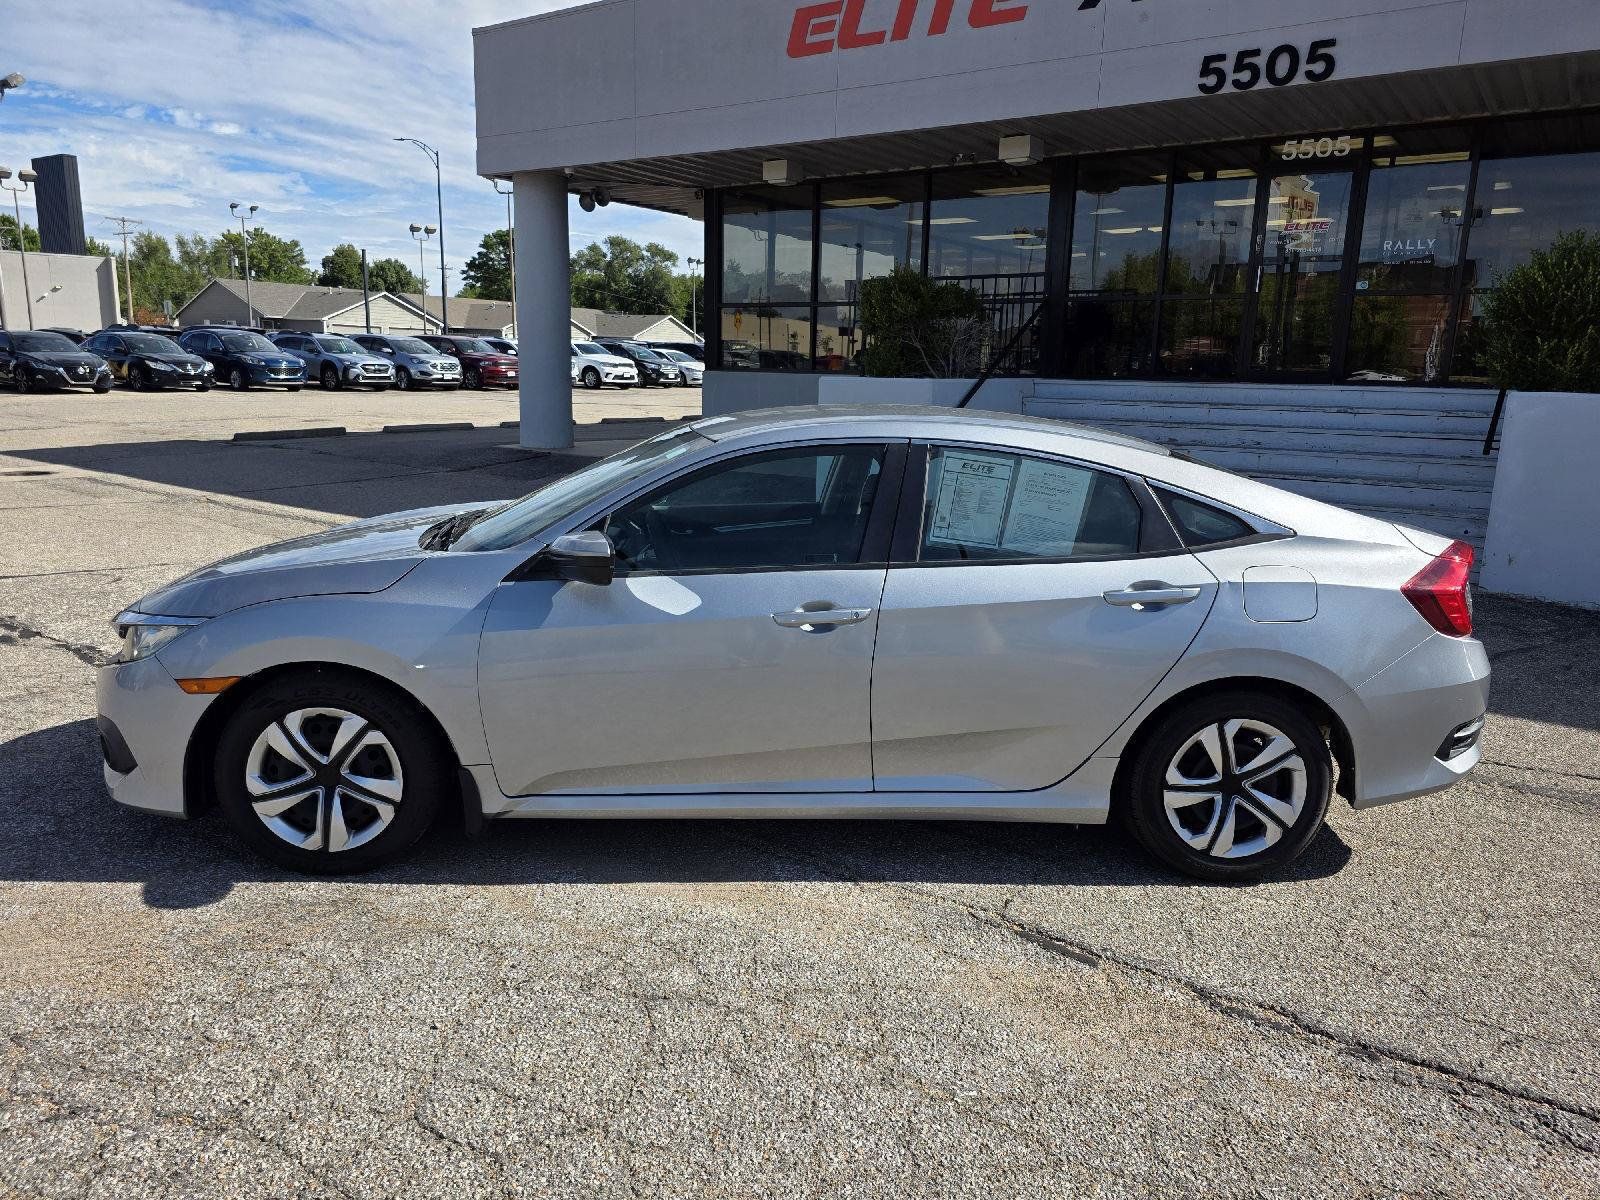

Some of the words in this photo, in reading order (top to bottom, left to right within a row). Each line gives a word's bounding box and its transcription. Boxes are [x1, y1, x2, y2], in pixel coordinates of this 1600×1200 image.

[1198, 38, 1336, 94] 5505
[1281, 136, 1351, 161] 5505
[1283, 221, 1331, 232] ELITE
[1383, 239, 1437, 251] RALLY
[961, 462, 995, 474] ELITE
